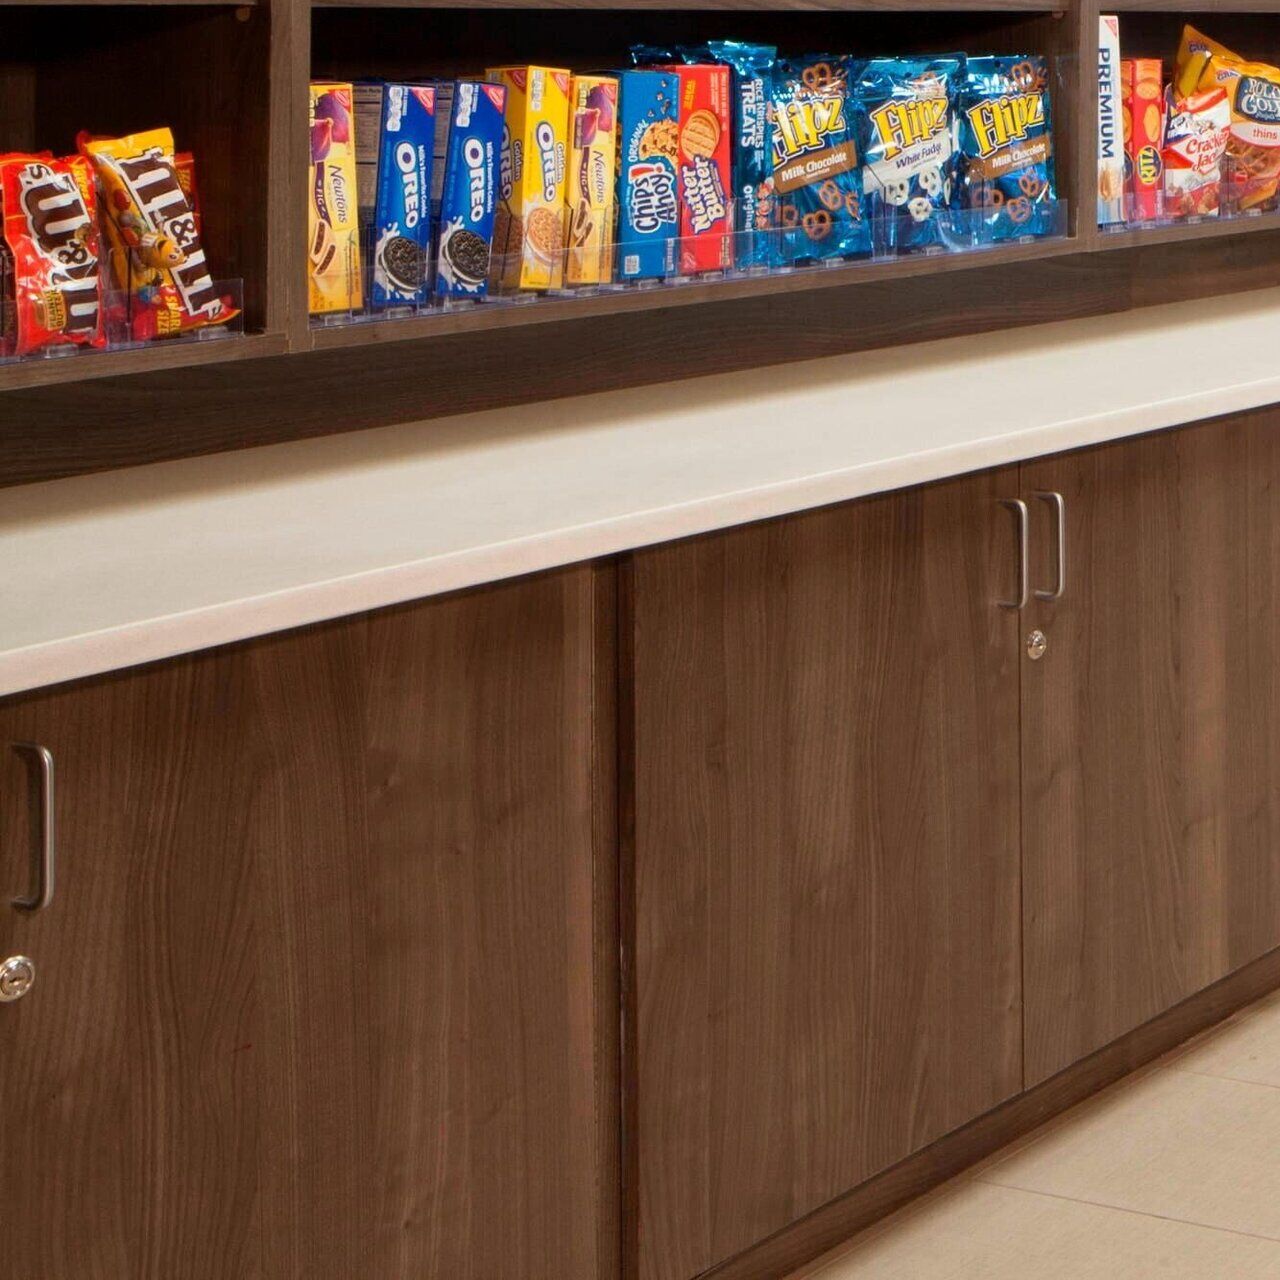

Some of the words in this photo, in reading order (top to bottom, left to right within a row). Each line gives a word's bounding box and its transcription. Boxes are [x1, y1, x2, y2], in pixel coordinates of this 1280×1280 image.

[741, 82, 755, 148] TREATS
[755, 78, 763, 98] RICE
[1098, 48, 1115, 159] PREMIUM
[628, 119, 650, 163] ORIGINAL
[755, 100, 764, 149] KRISPIES
[872, 97, 949, 160] Flipz
[968, 92, 1044, 159] Flipz
[1252, 127, 1279, 140] thins
[464, 138, 484, 222] OREO
[512, 140, 522, 181] Golden
[537, 123, 556, 202] OREO
[555, 143, 565, 183] Golden
[593, 150, 605, 205] Newtons
[781, 166, 806, 182] Milk
[806, 151, 847, 175] Chocolate
[896, 152, 921, 169] White
[922, 142, 943, 163] Fudge
[991, 155, 1011, 169] Milk
[1011, 143, 1047, 163] Chocolate
[1139, 147, 1157, 184] RITZ
[328, 165, 348, 224] Newtons
[396, 141, 419, 228] OREO
[632, 176, 659, 232] Chips
[684, 166, 711, 232] Nutter
[695, 156, 726, 220] Butter
[743, 184, 753, 232] Original
